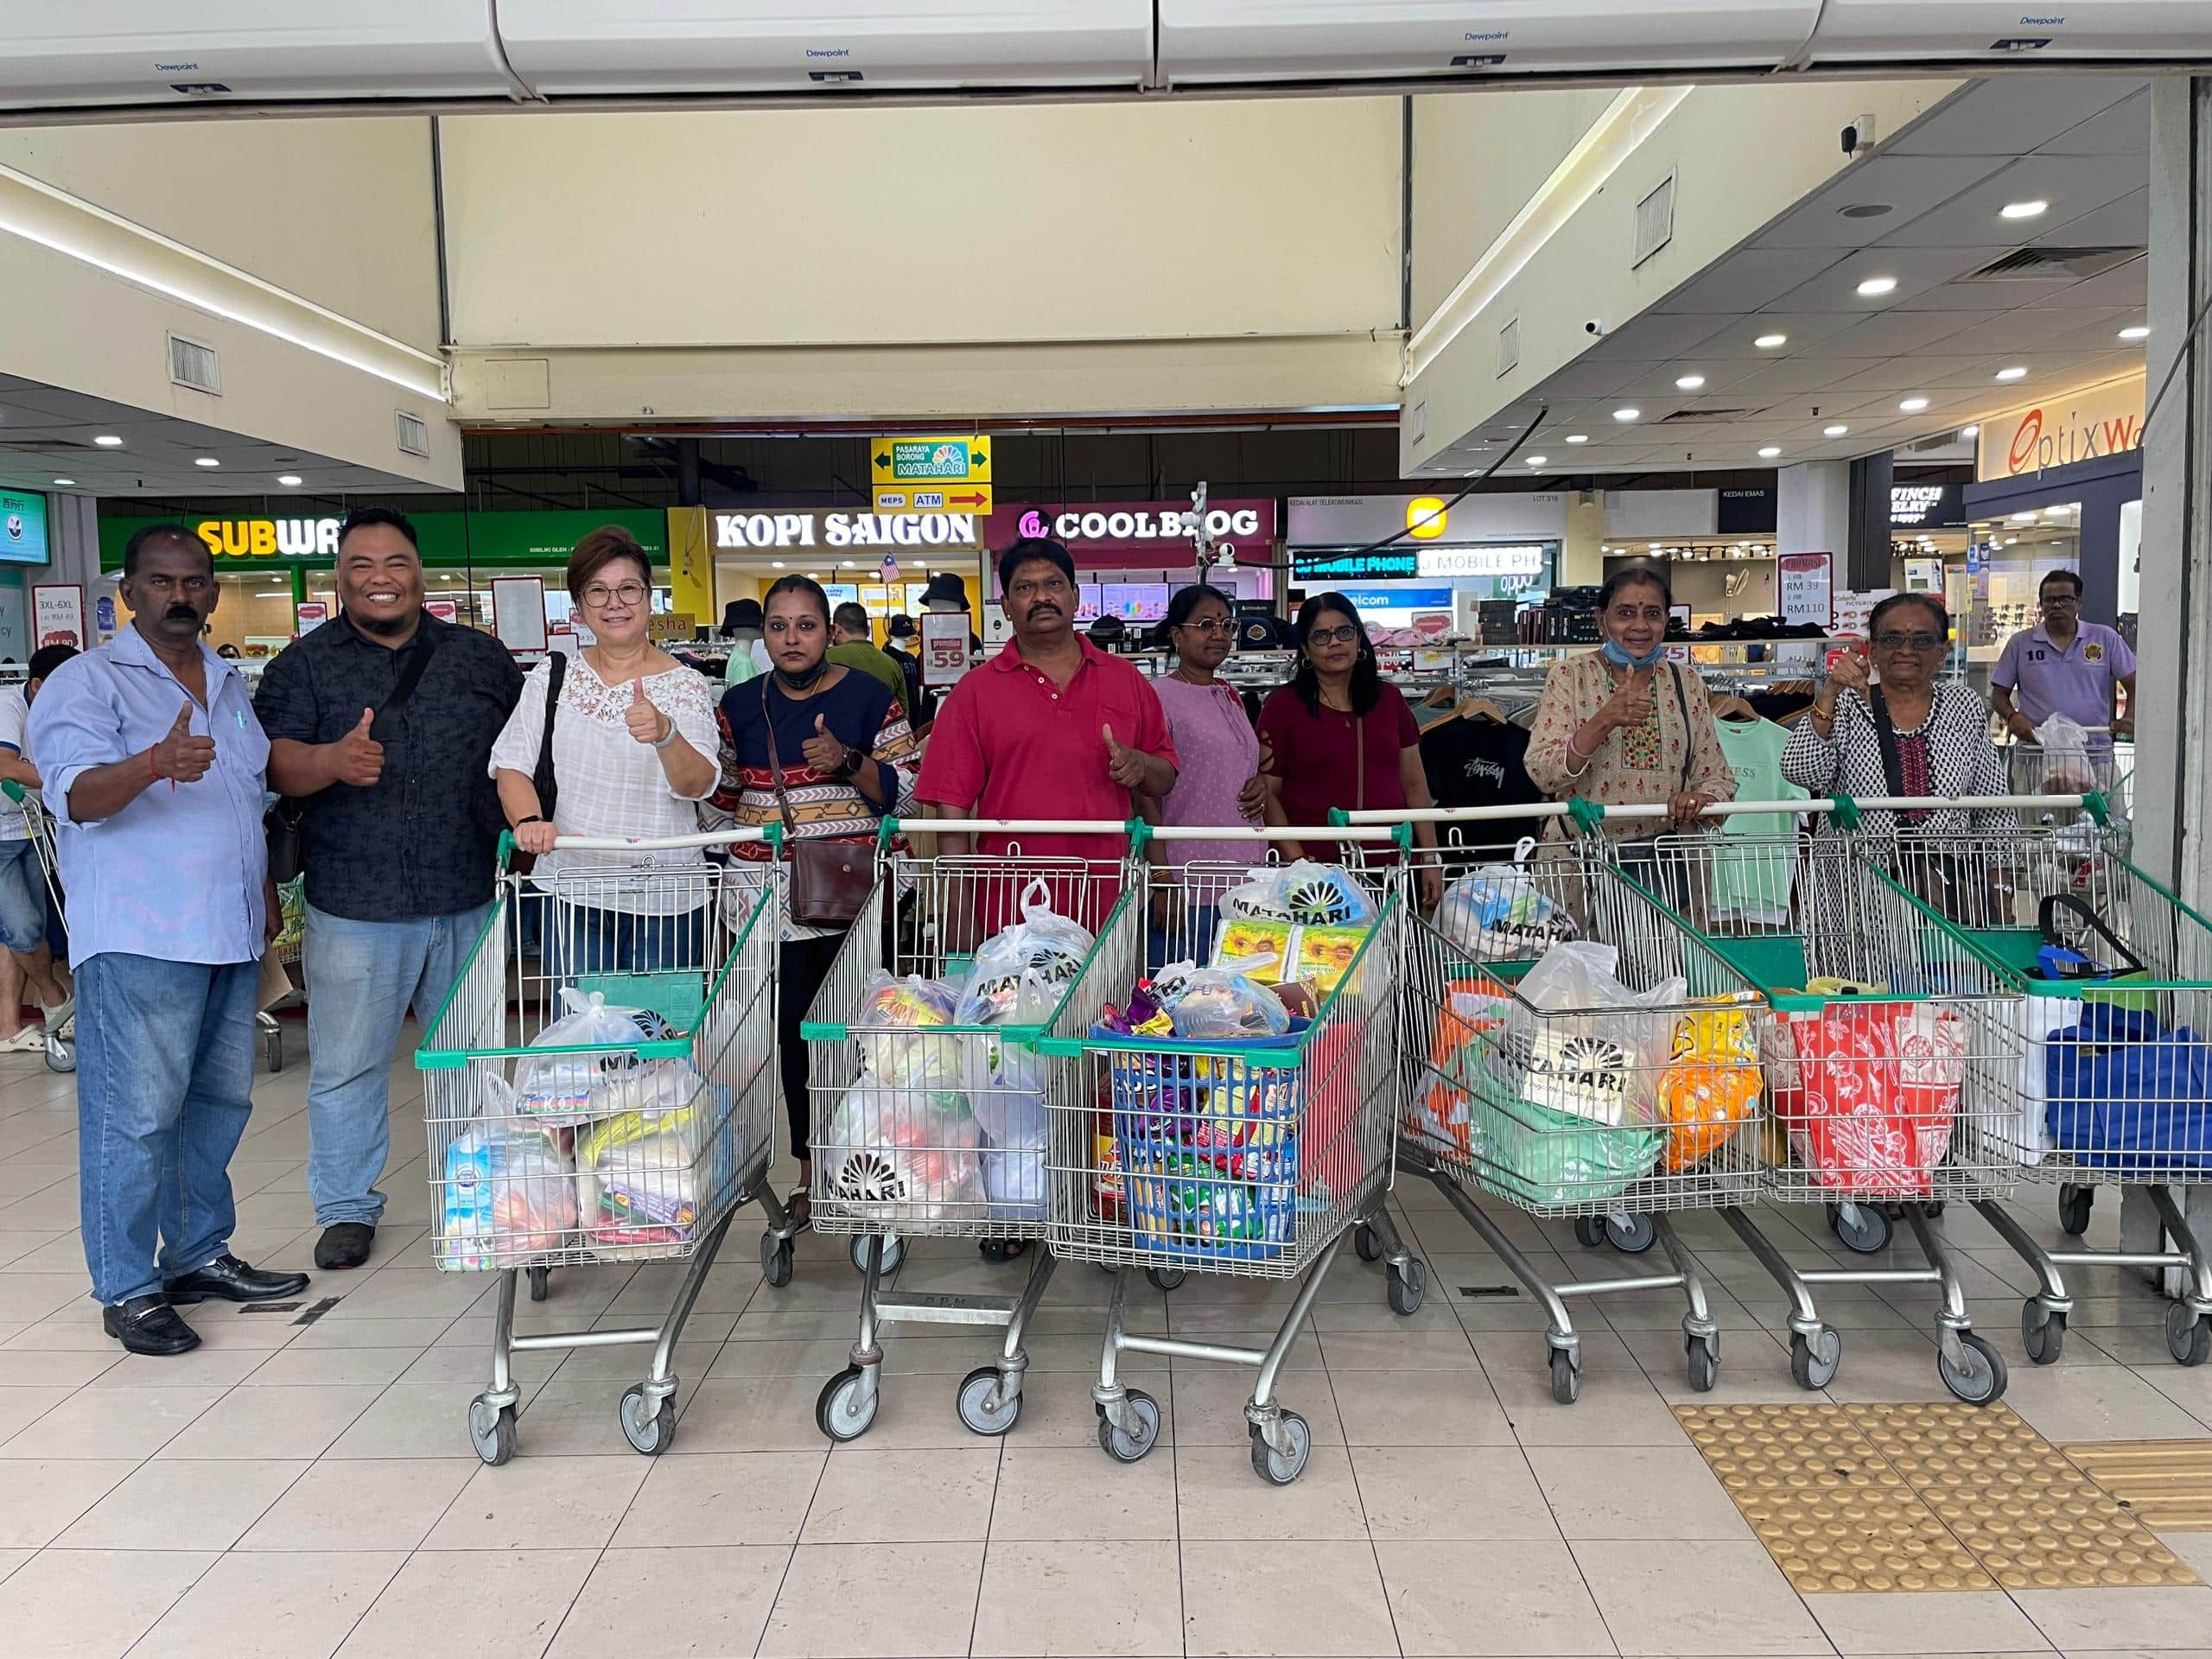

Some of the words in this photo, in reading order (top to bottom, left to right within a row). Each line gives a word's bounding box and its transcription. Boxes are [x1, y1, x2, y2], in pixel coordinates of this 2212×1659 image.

[2019, 16, 2064, 25] Dewpoint
[1465, 31, 1508, 41] Dewpoint
[806, 48, 849, 57] Dewpoint
[155, 62, 199, 71] Dewpoint
[896, 445, 930, 454] PASARAYA
[898, 462, 966, 475] MATAHARI
[916, 495, 941, 505] ATM
[1891, 500, 1929, 513] ELRY
[715, 514, 815, 547] KOPI
[824, 513, 976, 546] SAIGON
[198, 518, 345, 556] SUBWA
[1367, 556, 1415, 571] PHONE
[1787, 582, 1803, 591] RM
[1807, 582, 1819, 590] 39
[1352, 595, 1389, 606] elcom
[648, 619, 688, 630] esha
[934, 651, 965, 669] 59
[2025, 650, 2045, 661] 10
[976, 959, 1082, 998] MATHARI
